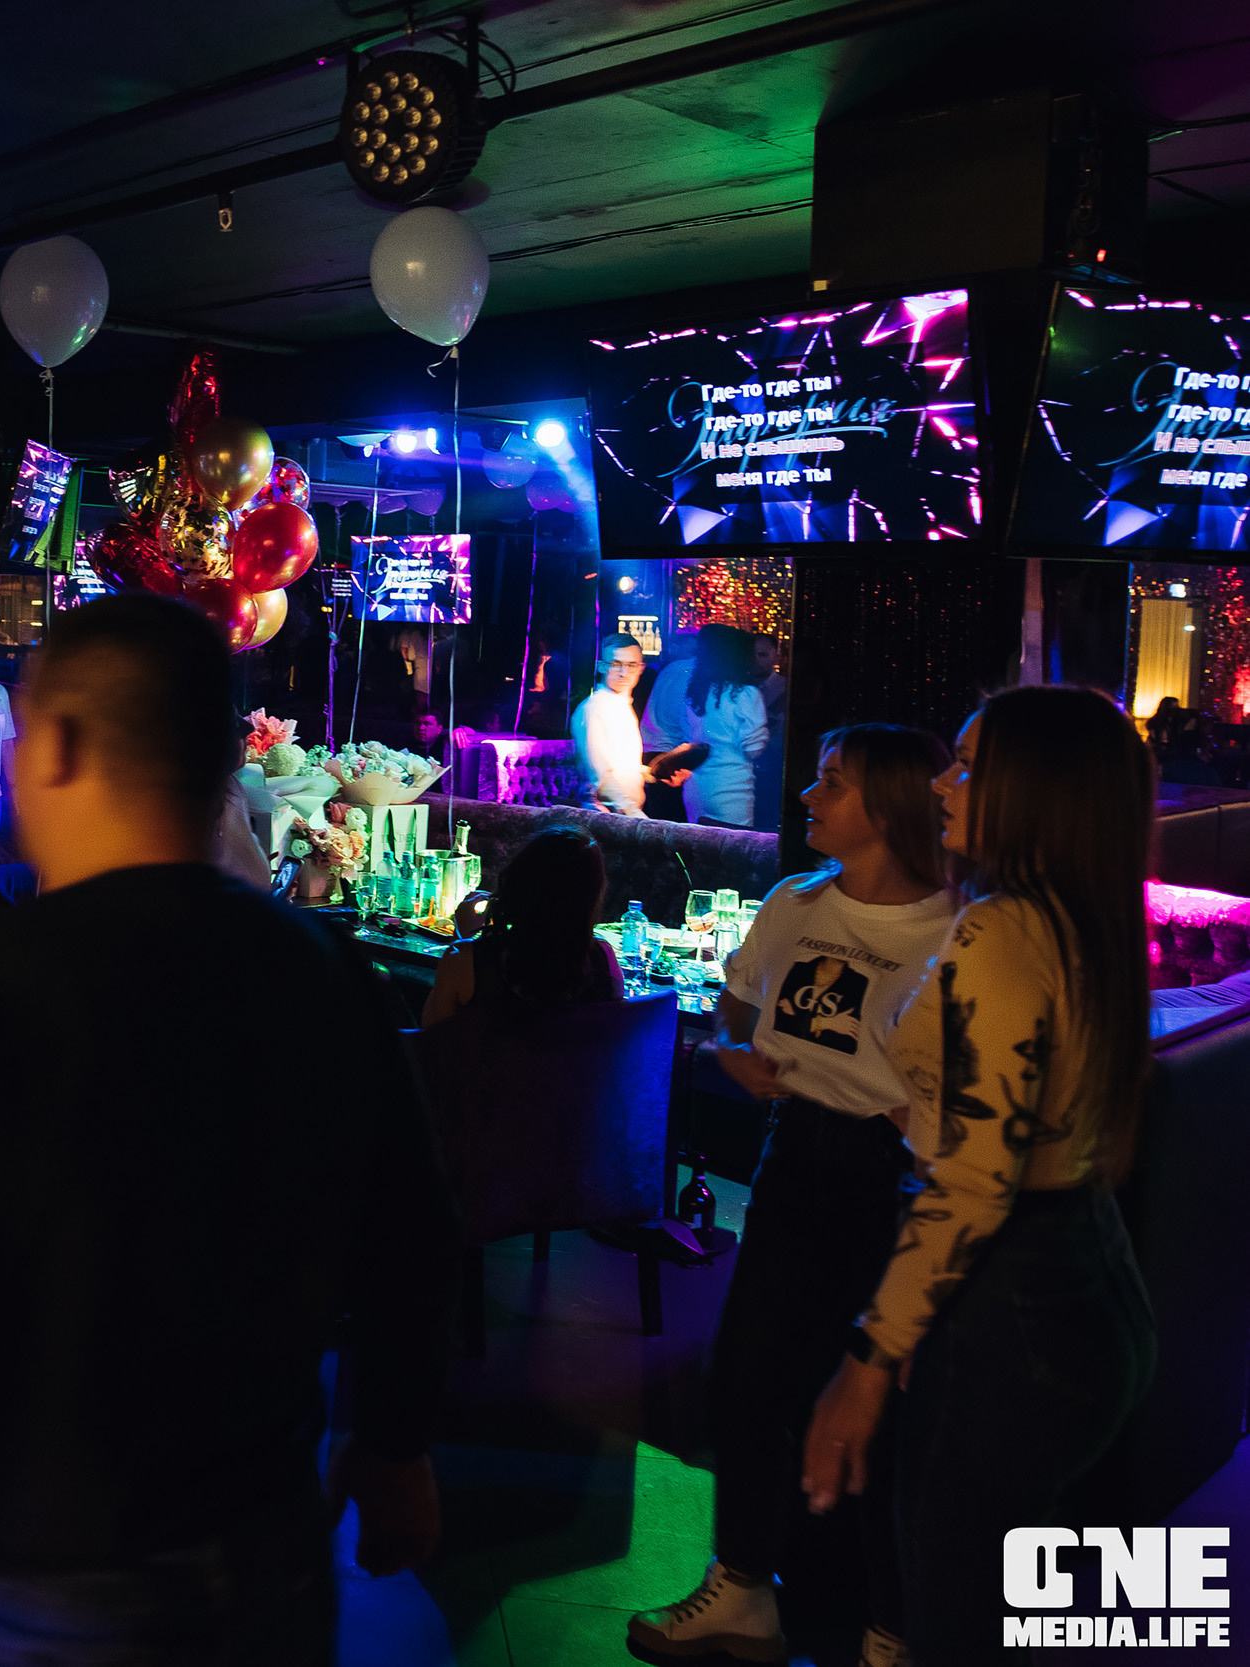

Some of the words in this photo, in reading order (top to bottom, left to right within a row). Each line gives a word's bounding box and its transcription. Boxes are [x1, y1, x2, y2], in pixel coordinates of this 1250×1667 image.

[701, 383, 763, 403] Где-то
[765, 379, 800, 397] где
[802, 375, 832, 392] ты
[1173, 366, 1240, 390] Где-то
[704, 412, 765, 432] где-то
[767, 409, 802, 427] где
[804, 406, 834, 422] ты
[1167, 403, 1232, 422] где-то
[700, 441, 717, 460] И
[718, 443, 744, 458] не
[744, 436, 846, 457] слышишь
[1153, 431, 1173, 451] И
[1172, 437, 1200, 453] не
[715, 471, 764, 488] меня
[765, 469, 801, 486] где
[802, 467, 832, 483] ты
[1159, 469, 1211, 485] меня
[1212, 472, 1248, 489] где
[796, 936, 849, 956] FASHION
[847, 948, 903, 971] LUXURY
